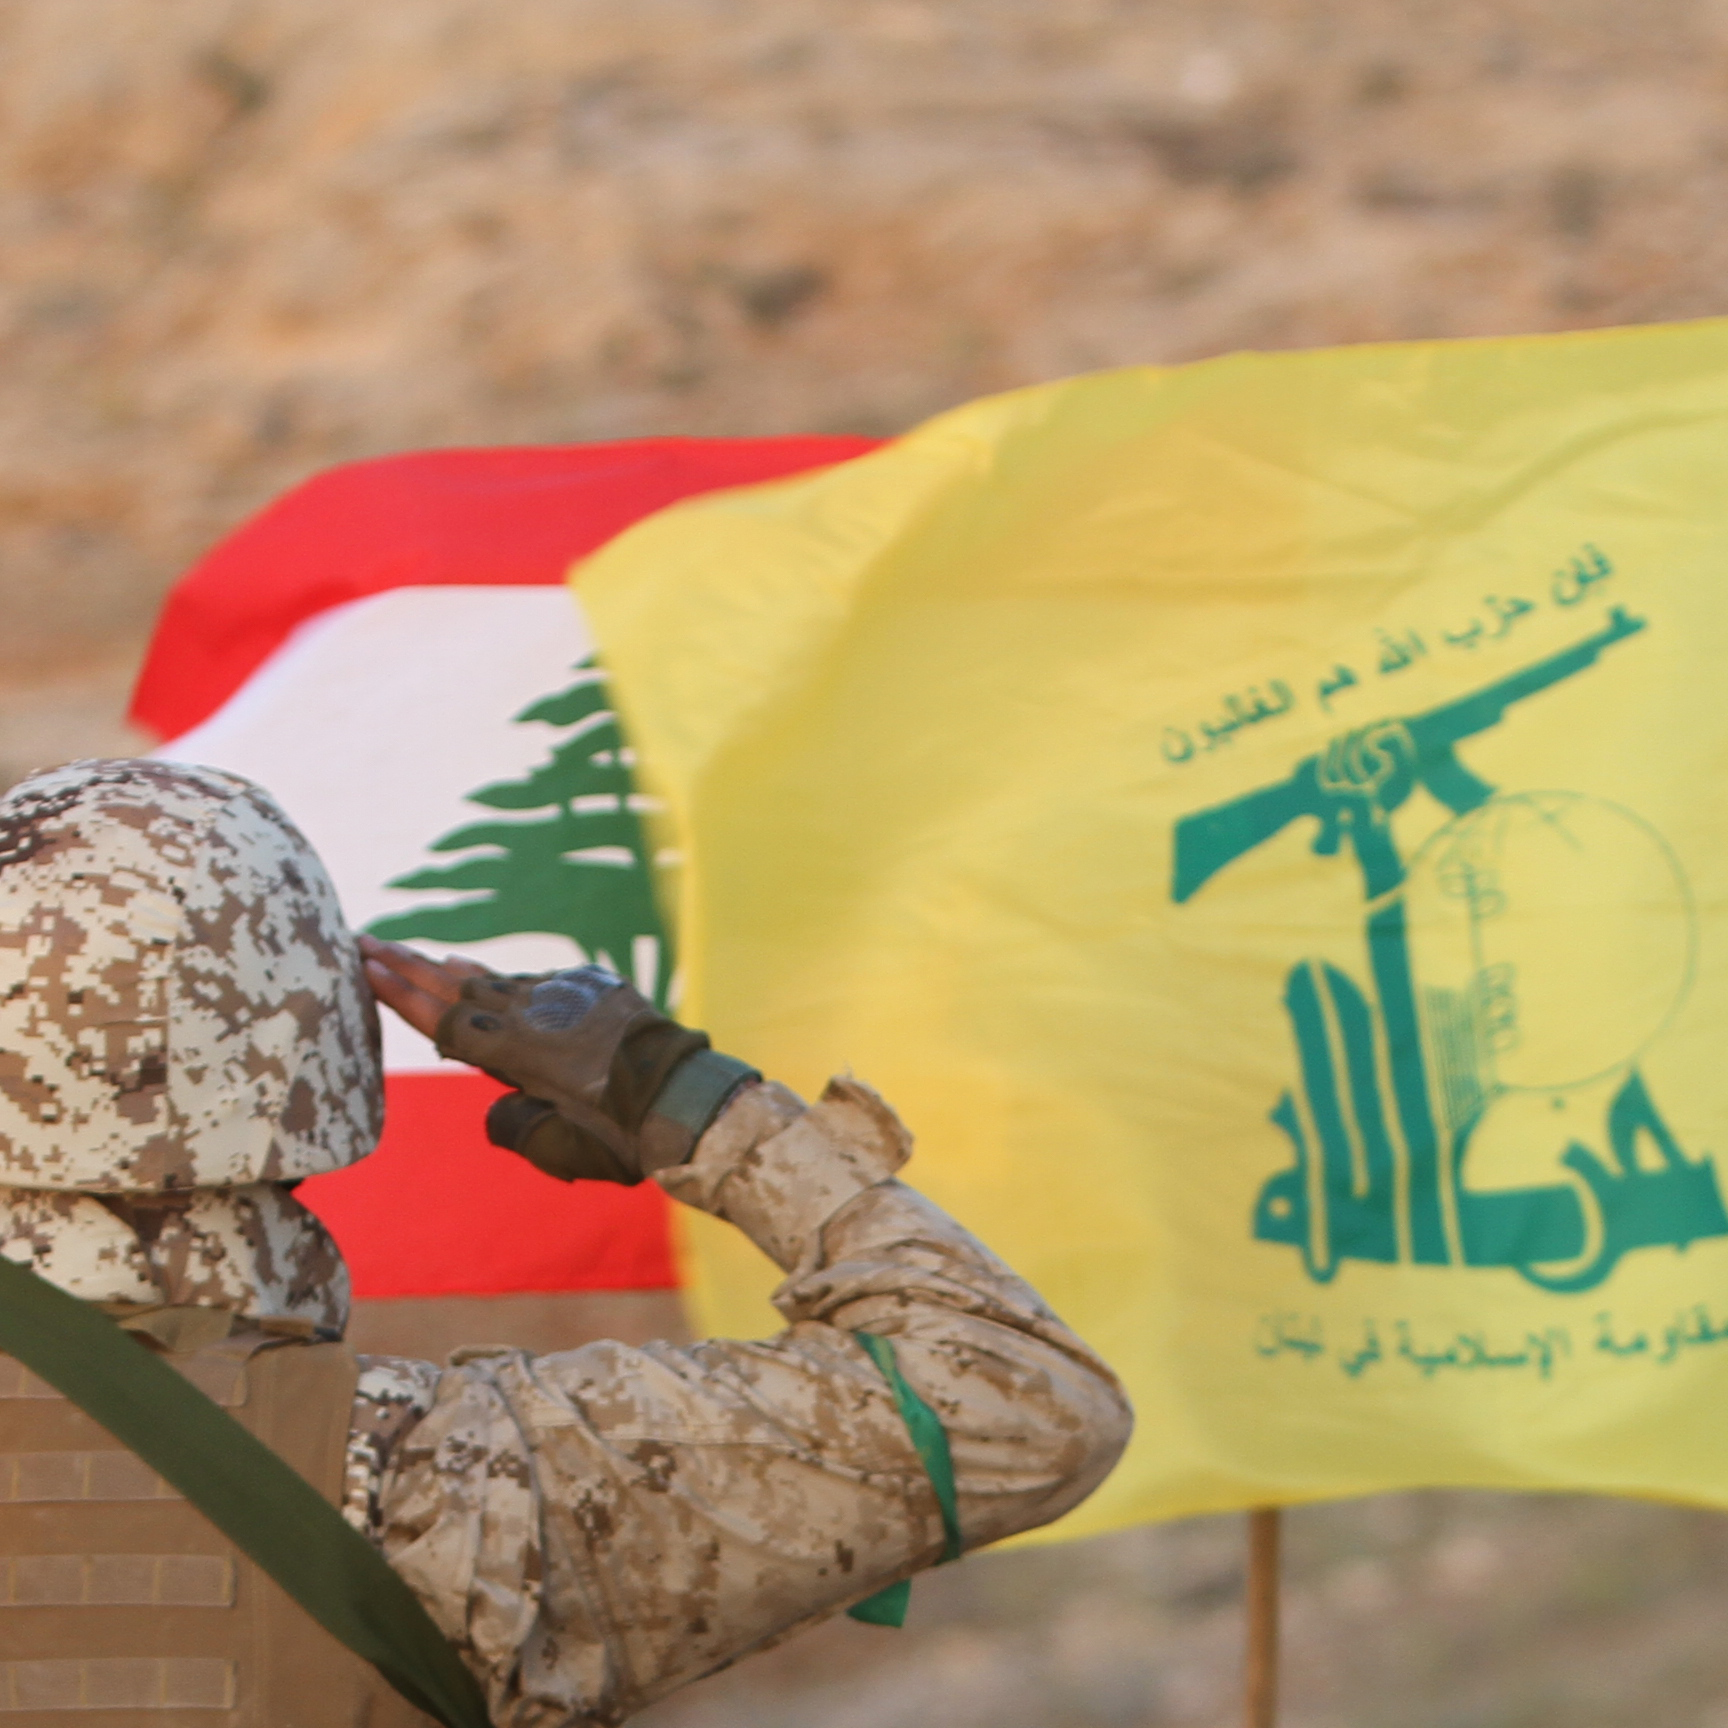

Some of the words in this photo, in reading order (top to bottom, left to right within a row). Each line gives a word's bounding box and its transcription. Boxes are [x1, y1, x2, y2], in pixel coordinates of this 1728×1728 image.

[1443, 594, 1535, 649] حزب
[1374, 627, 1429, 675] الله
[1317, 663, 1359, 715] هم
[1340, 1317, 1381, 1379] في
